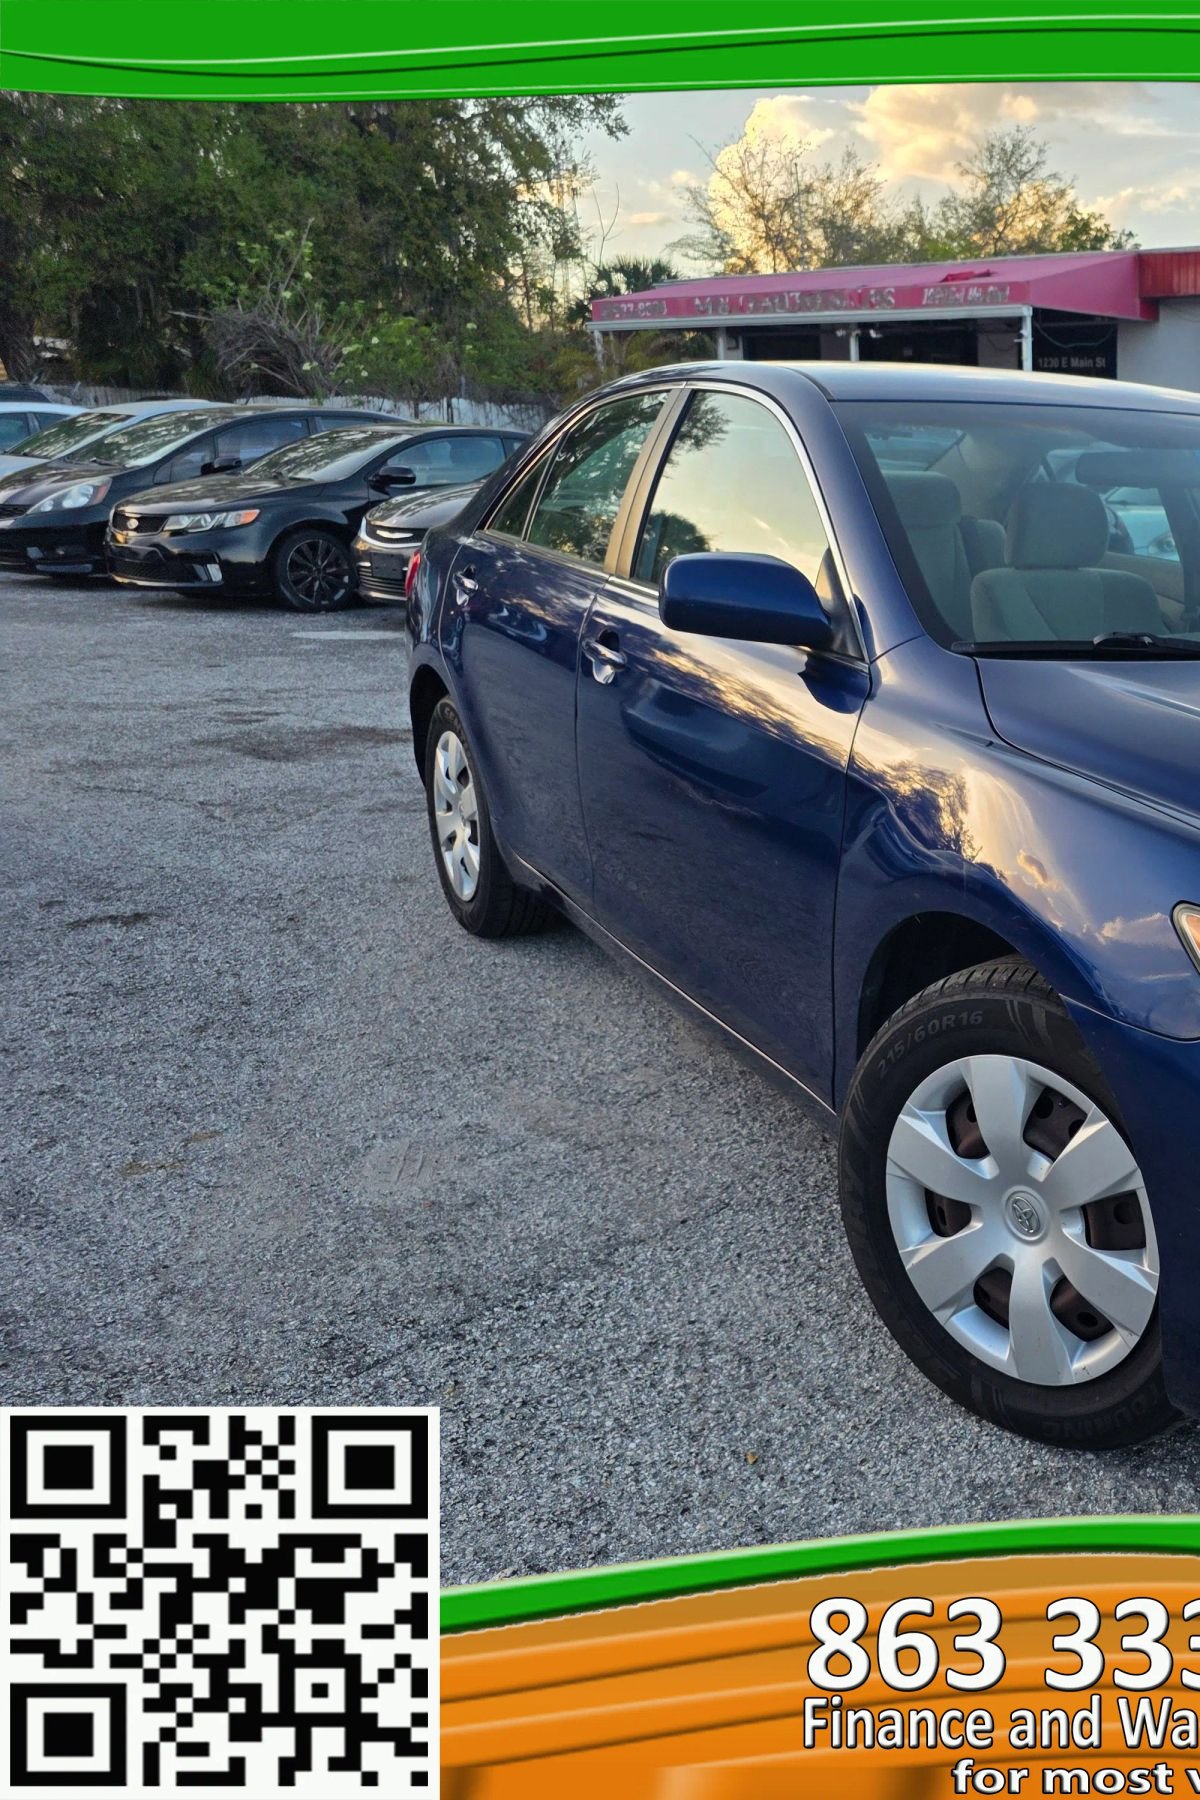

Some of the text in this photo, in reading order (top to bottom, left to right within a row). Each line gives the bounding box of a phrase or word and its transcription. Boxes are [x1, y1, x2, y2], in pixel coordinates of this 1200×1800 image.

[1038, 356, 1106, 368] 1230 E Main St
[878, 1010, 984, 1078] 215/60R16
